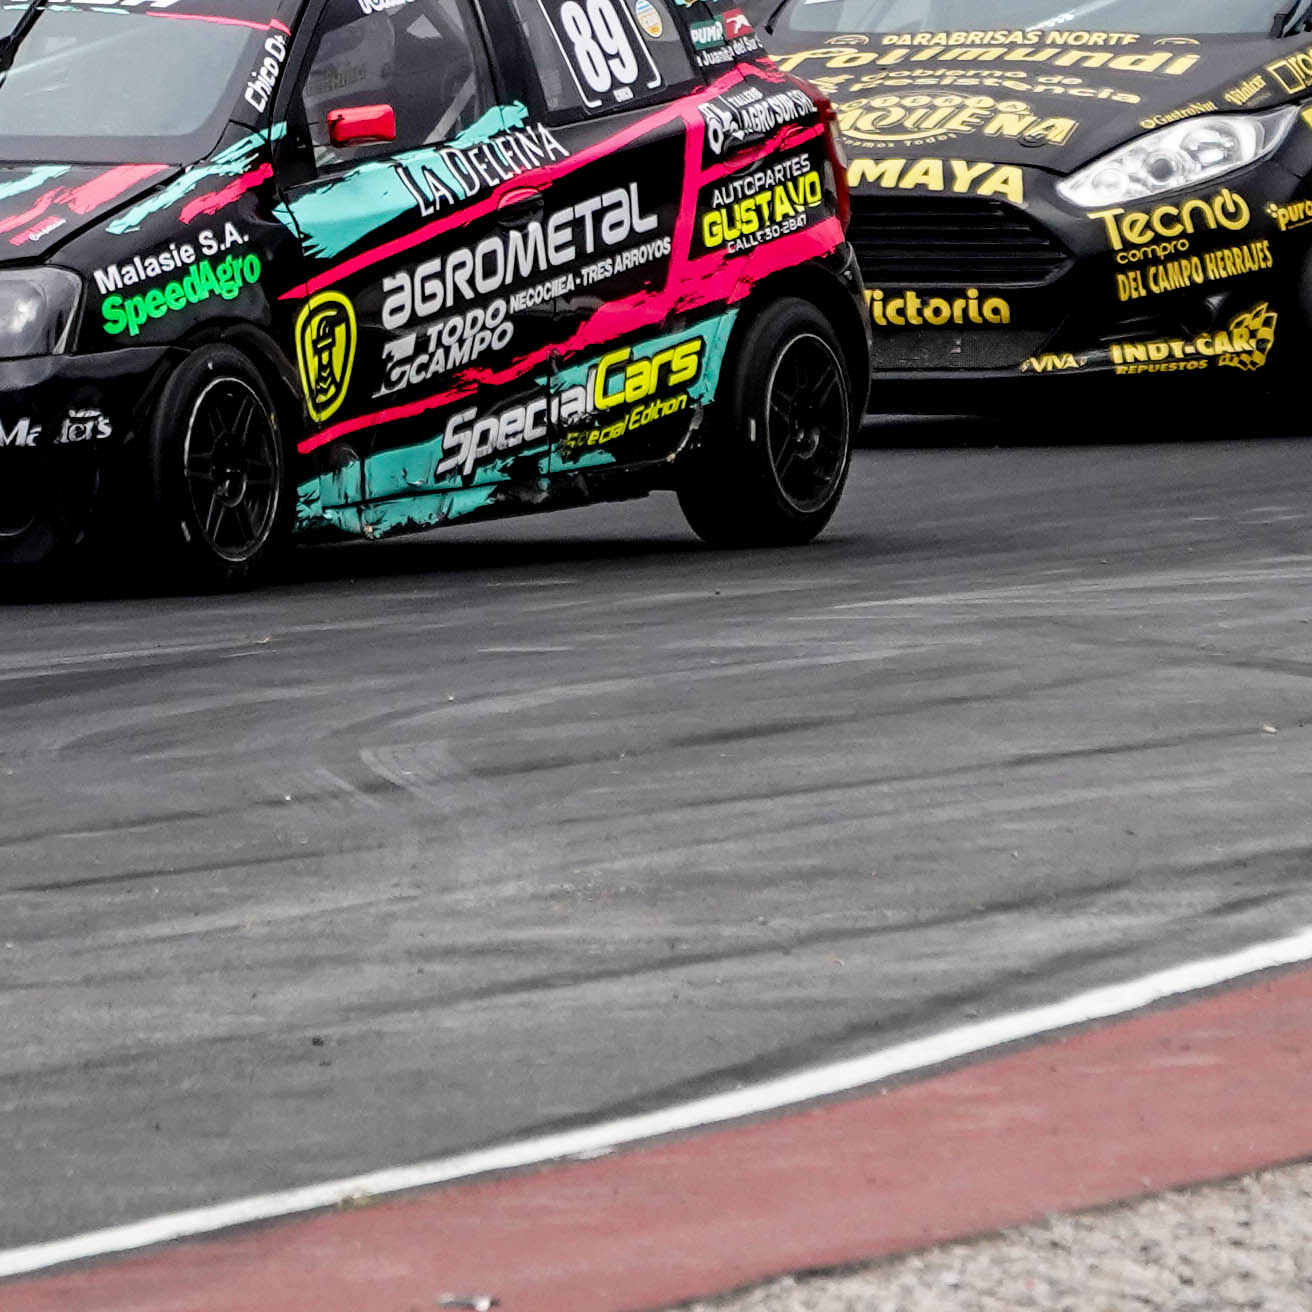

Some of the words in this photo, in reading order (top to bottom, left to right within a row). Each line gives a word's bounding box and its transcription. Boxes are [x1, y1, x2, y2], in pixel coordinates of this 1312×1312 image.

[244, 56, 280, 114] Chico
[701, 170, 823, 249] GUSTAVO
[711, 153, 812, 209] AUTOPARTES
[846, 159, 1025, 204] MAYA
[1087, 188, 1251, 251] Tecno
[93, 237, 196, 295] Malasie
[198, 222, 250, 257] S.A.
[509, 274, 576, 314] NECOCHEA
[580, 253, 613, 287] TRES
[613, 235, 673, 277] ARROYOS
[1115, 237, 1191, 266] compro
[1116, 267, 1145, 302] DEL
[1147, 256, 1203, 293] CAMPO
[1205, 239, 1275, 284] HERRAJES
[101, 253, 262, 336] SpeedAgro
[426, 298, 508, 348] TODO
[407, 320, 515, 387] CAMPO
[1109, 328, 1256, 365] INDY-CAR
[1114, 359, 1209, 375] REPUESTOS
[628, 393, 688, 431] Edition
